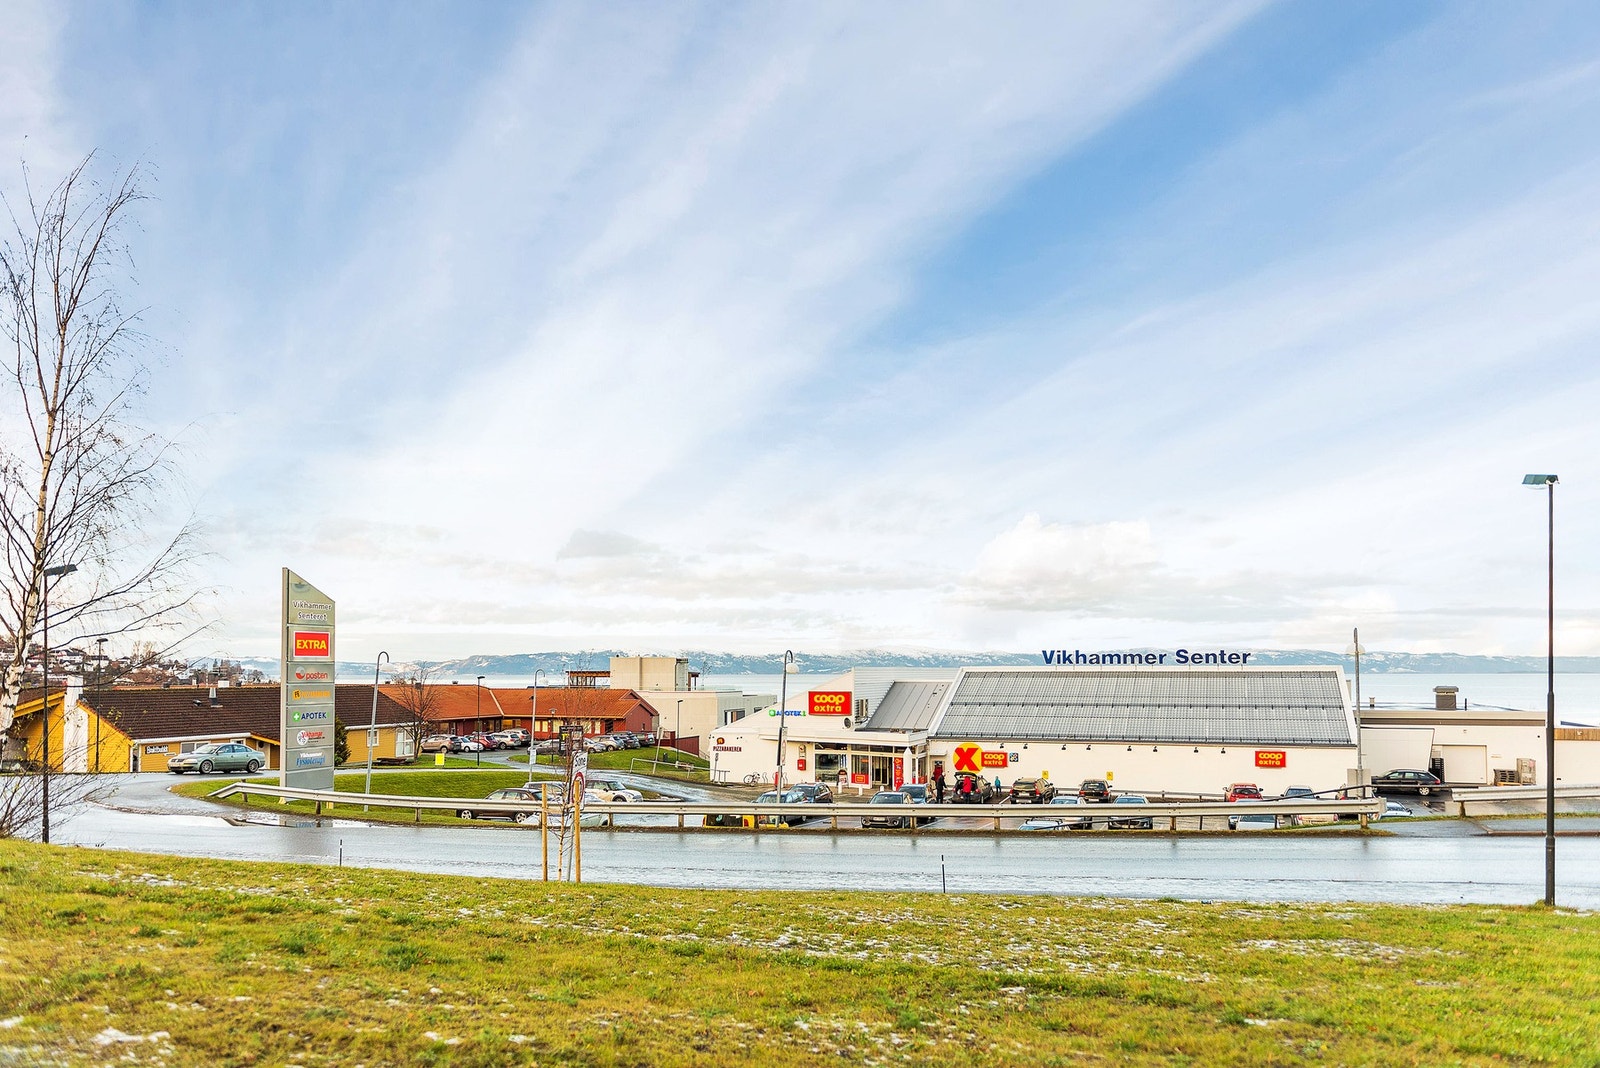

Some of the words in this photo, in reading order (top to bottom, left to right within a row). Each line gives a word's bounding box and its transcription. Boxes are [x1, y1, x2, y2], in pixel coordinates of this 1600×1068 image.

[293, 601, 332, 610] Vikhammer
[298, 611, 327, 621] Senteret
[296, 639, 327, 650] EXTRA
[1042, 650, 1167, 665] Vikhammer
[1175, 649, 1251, 665] Senter
[305, 672, 328, 680] posten
[813, 694, 845, 705] coop
[301, 711, 327, 720] APOTEK
[1258, 752, 1283, 760] coop
